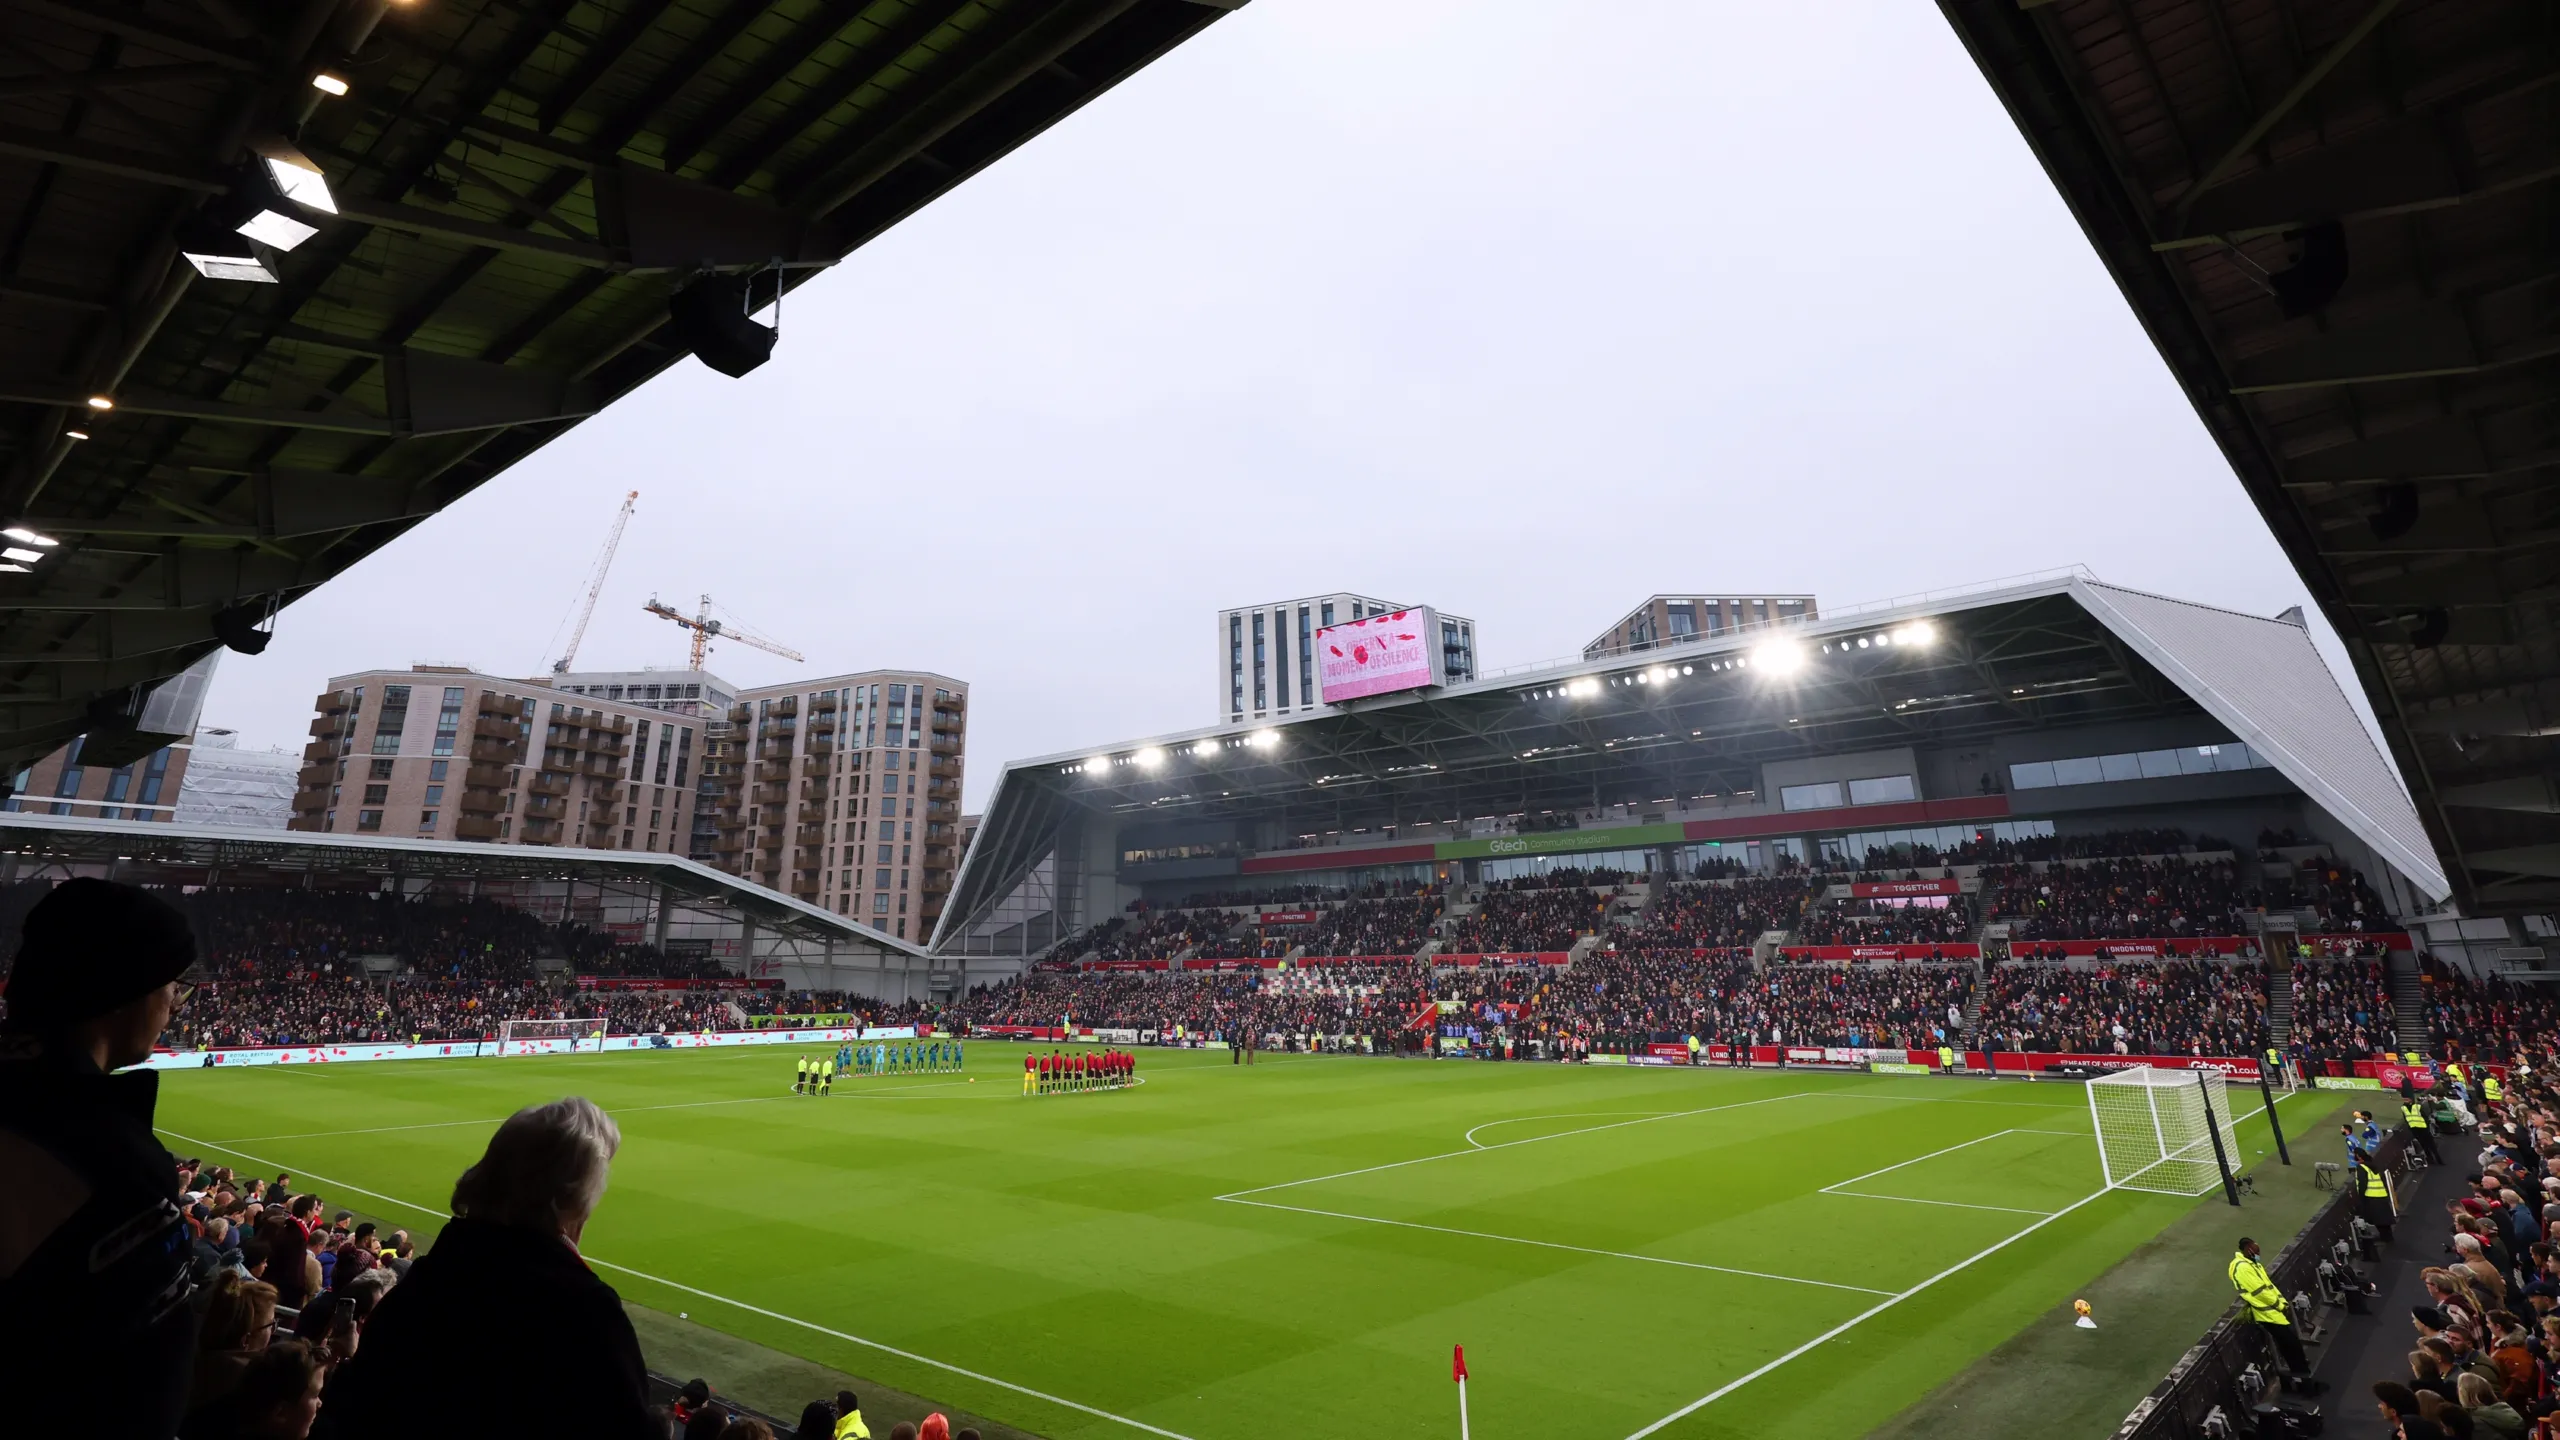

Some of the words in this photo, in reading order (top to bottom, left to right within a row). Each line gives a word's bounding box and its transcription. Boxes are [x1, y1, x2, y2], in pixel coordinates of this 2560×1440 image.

[1490, 838, 1527, 852] Gtech
[1530, 838, 1575, 849] Community
[1577, 834, 1610, 845] Stadium
